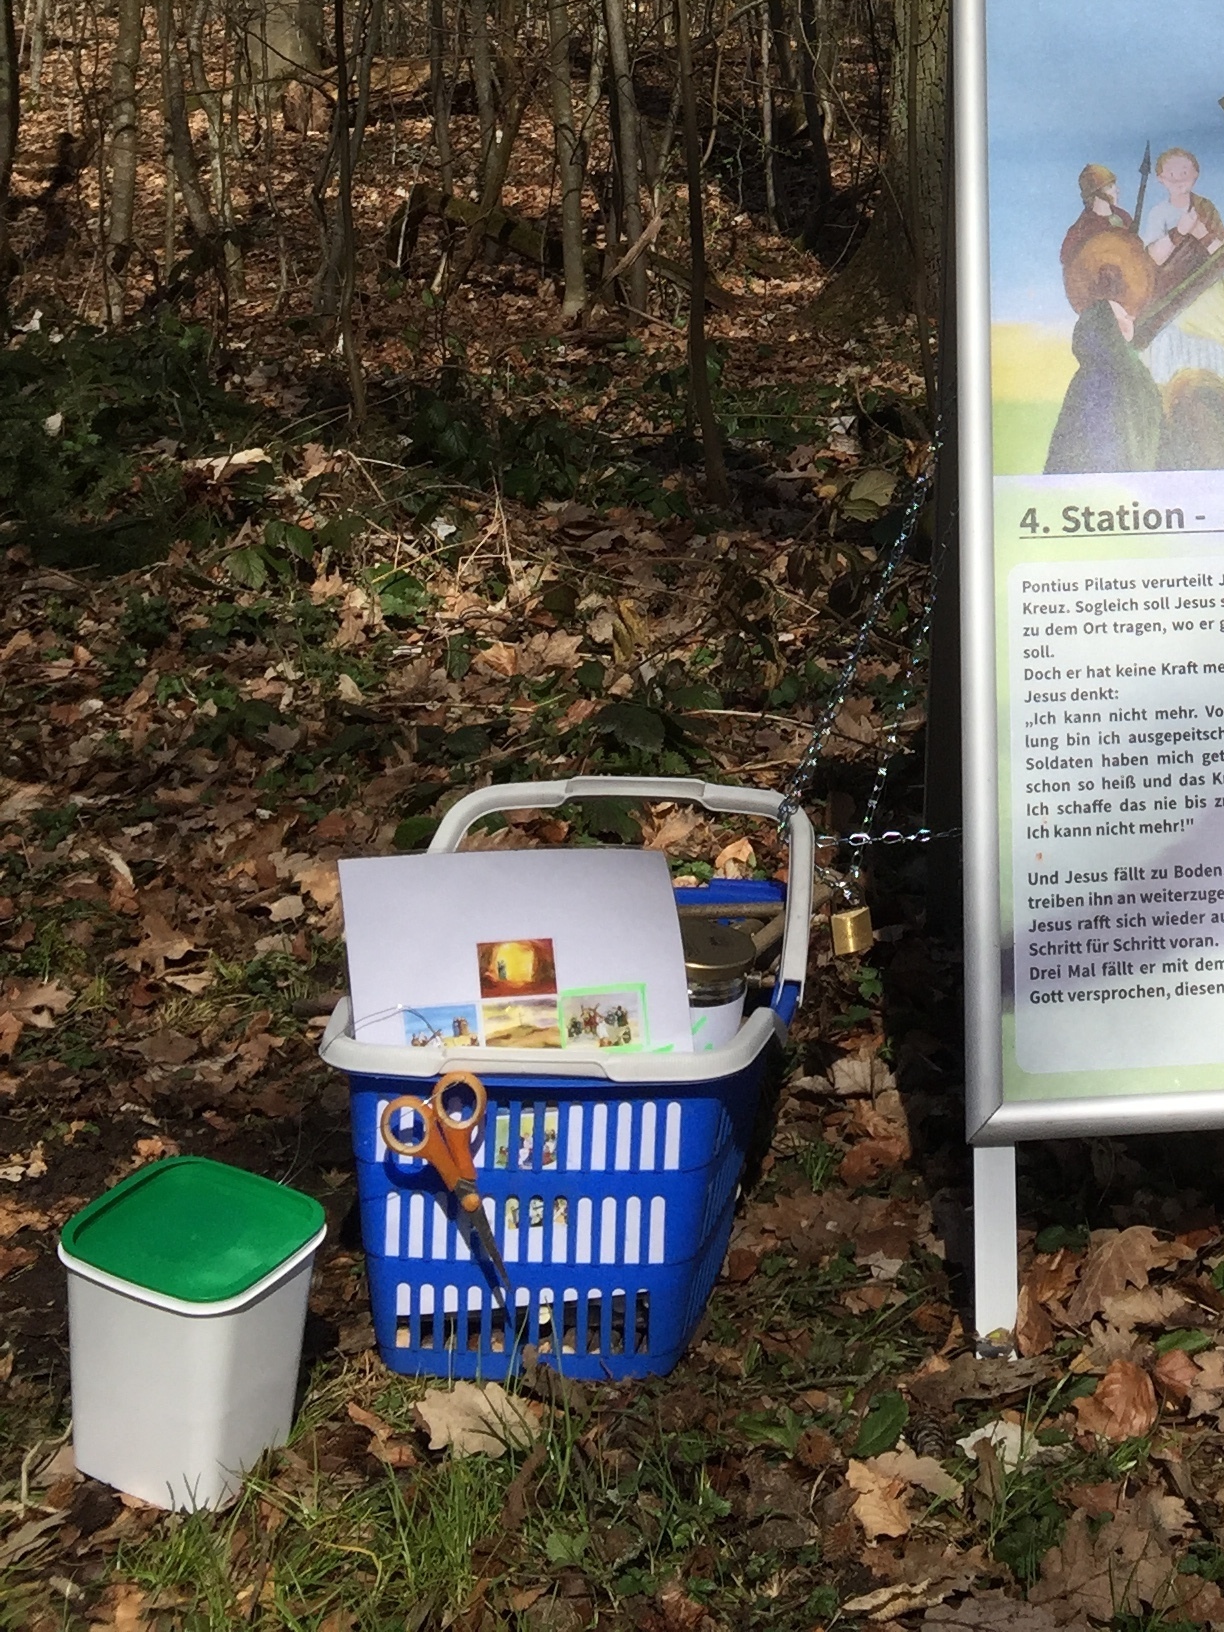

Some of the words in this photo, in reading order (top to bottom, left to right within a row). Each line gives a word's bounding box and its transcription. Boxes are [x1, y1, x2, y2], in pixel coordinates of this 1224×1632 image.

[1019, 507, 1050, 534] 4.
[1062, 502, 1184, 533] Station
[1022, 578, 1078, 592] Pontius
[1084, 577, 1136, 590] Pilatus
[1141, 573, 1213, 588] verurteilt
[1022, 602, 1070, 614] Kreuz.
[1075, 598, 1138, 615] Sogleich
[1143, 596, 1169, 610] soll
[1174, 596, 1215, 609] Jesus
[1022, 626, 1039, 636] zu
[1044, 622, 1077, 635] dem
[1083, 621, 1107, 634] Ort
[1112, 621, 1166, 636] tragen,
[1171, 620, 1194, 630] wo
[1199, 619, 1214, 630] er
[1023, 644, 1054, 658] soll.
[1024, 666, 1061, 680] Doch
[1066, 668, 1081, 679] er
[1086, 665, 1111, 678] hat
[1115, 662, 1156, 677] keine
[1161, 660, 1198, 675] Kraft
[1024, 690, 1066, 703] Jesus
[1070, 686, 1118, 701] denkt:
[1063, 710, 1101, 723] kann
[1109, 707, 1147, 721] nicht
[1154, 705, 1197, 719] mehr.
[1025, 734, 1059, 750] lung
[1066, 732, 1090, 746] bin
[1098, 730, 1120, 745] ich
[1025, 756, 1093, 770] Soldaten
[1101, 752, 1148, 767] haben
[1156, 750, 1193, 764] mich
[1025, 779, 1070, 793] schon
[1077, 780, 1094, 791] so
[1101, 774, 1136, 789] heiß
[1142, 773, 1171, 788] und
[1178, 772, 1205, 786] das
[1026, 801, 1049, 816] Ich
[1057, 799, 1111, 814] schaffe
[1119, 797, 1146, 811] das
[1154, 795, 1177, 810] nie
[1184, 794, 1206, 809] bis
[1027, 824, 1049, 839] Ich
[1053, 824, 1091, 837] kann
[1095, 821, 1135, 835] nicht
[1027, 870, 1058, 885] Und
[1064, 870, 1108, 883] Jesus
[1113, 866, 1145, 881] fällt
[1150, 868, 1167, 879] zu
[1027, 893, 1084, 909] treiben
[1088, 891, 1113, 906] ihn
[1116, 893, 1135, 904] an
[1028, 919, 1072, 932] Jesus
[1077, 914, 1111, 929] rafft
[1115, 912, 1146, 928] sich
[1151, 910, 1205, 925] wieder
[1029, 940, 1082, 956] Schritt
[1085, 938, 1109, 953] für
[1113, 935, 1166, 951] Schritt
[1168, 936, 1219, 948] voran.
[1029, 964, 1061, 980] Drei
[1067, 962, 1096, 978] Mal
[1101, 960, 1133, 976] fällt
[1139, 963, 1156, 974] er
[1162, 958, 1188, 973] mit
[1029, 989, 1064, 1004] Gott
[1067, 984, 1170, 1003] versprochen,
[1174, 981, 1224, 996] diesen
